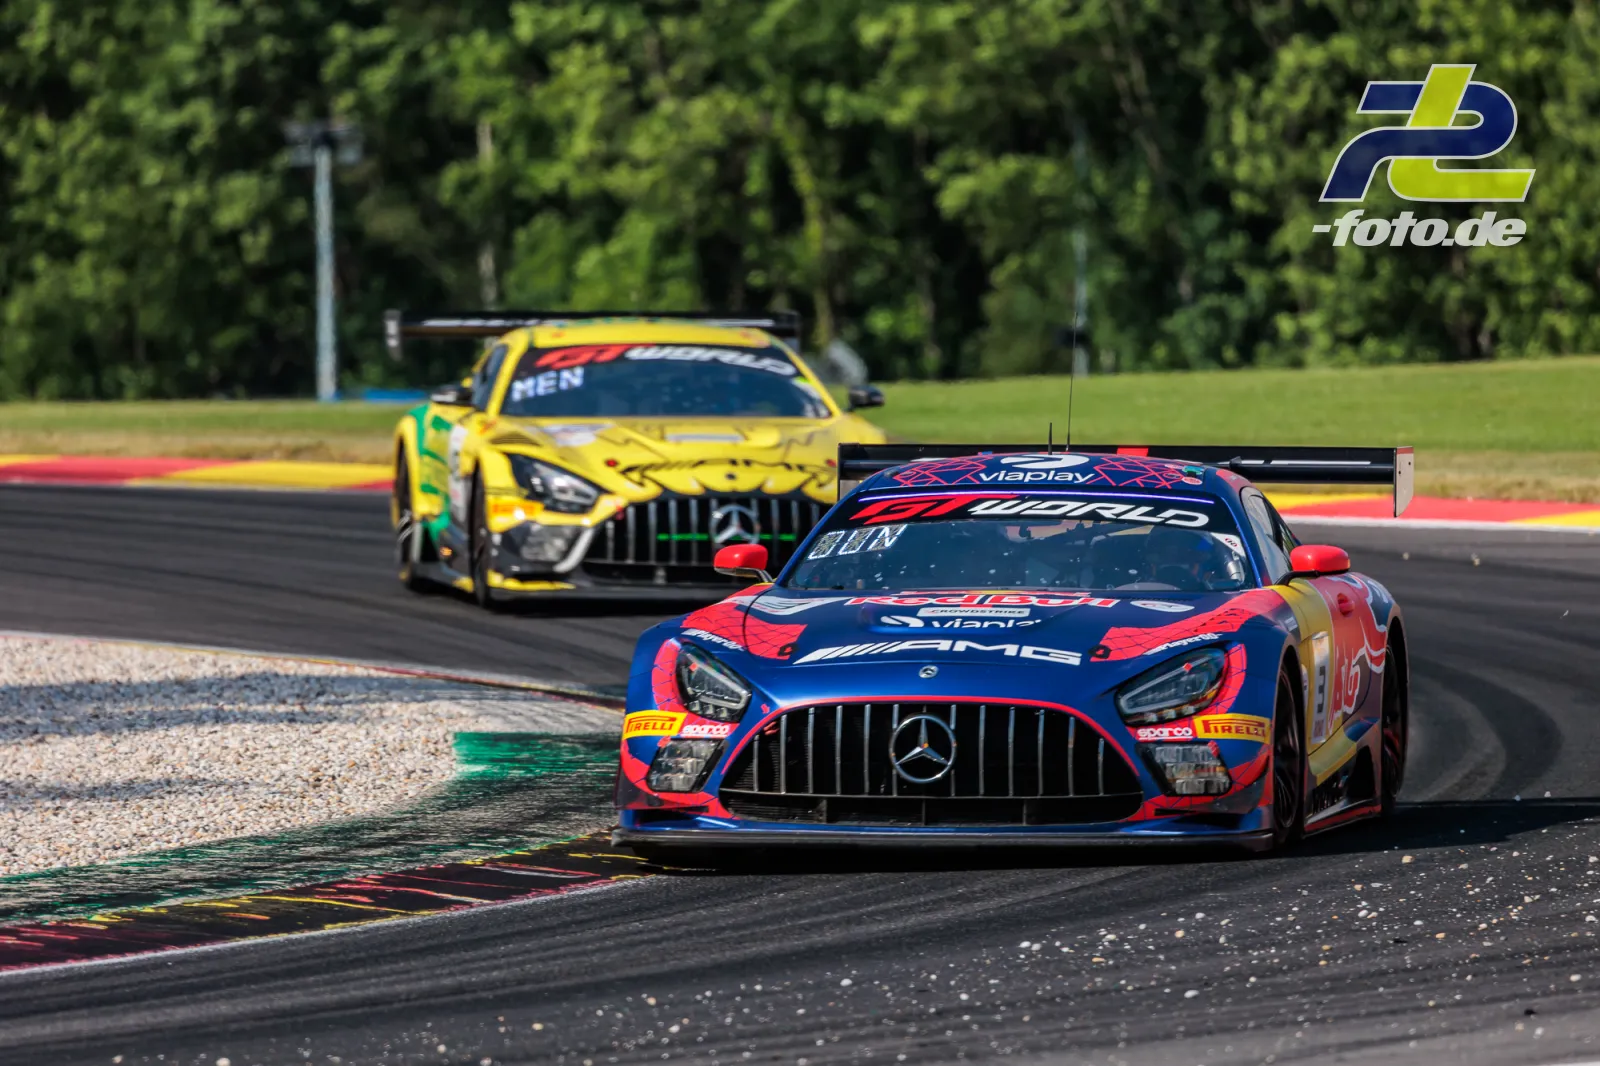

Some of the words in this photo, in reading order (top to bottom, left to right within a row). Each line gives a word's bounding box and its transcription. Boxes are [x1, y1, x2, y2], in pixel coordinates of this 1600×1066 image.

[534, 343, 656, 370] GT
[624, 346, 798, 376] WORLD
[511, 366, 585, 402] MEN
[979, 468, 1097, 483] viaplay
[850, 494, 1028, 525] GT
[968, 498, 1209, 528] WORLD
[882, 639, 1083, 667] AMG
[625, 715, 677, 734] PIRELLI
[682, 723, 729, 734] sparco
[1137, 727, 1193, 738] sparco
[1201, 718, 1266, 738] PIRELLI
